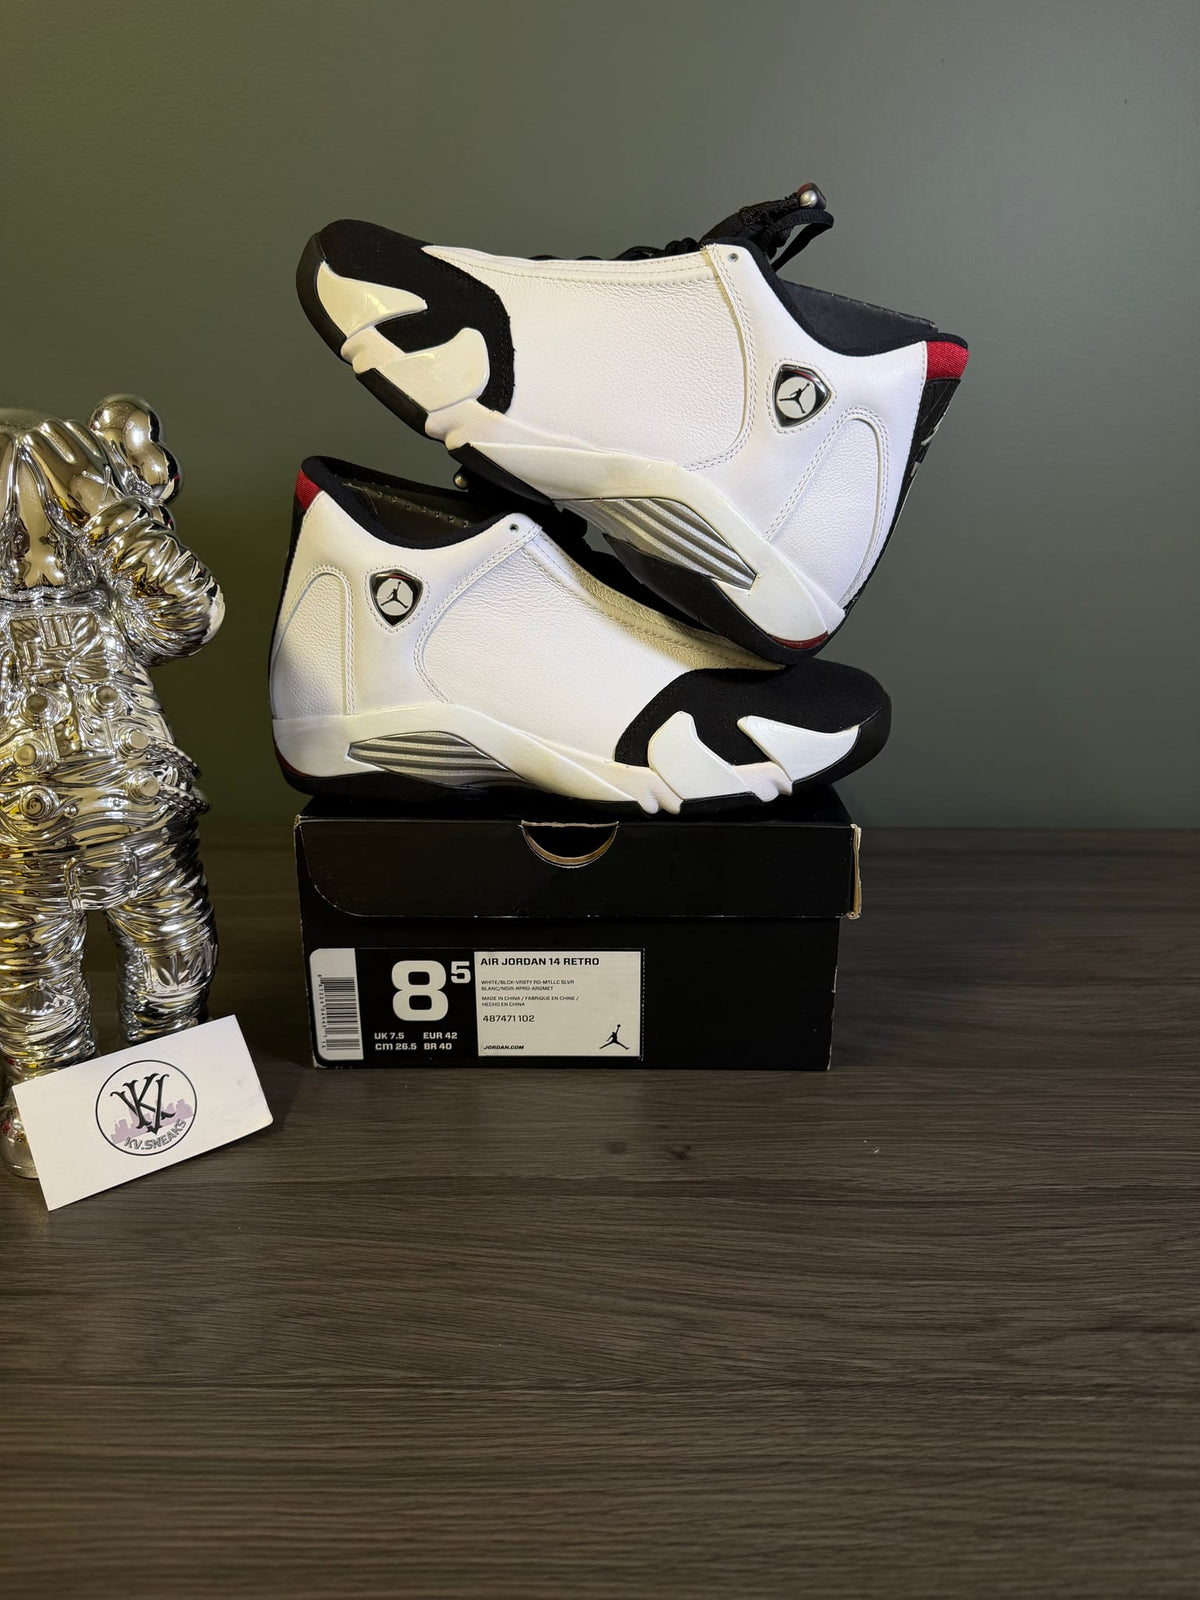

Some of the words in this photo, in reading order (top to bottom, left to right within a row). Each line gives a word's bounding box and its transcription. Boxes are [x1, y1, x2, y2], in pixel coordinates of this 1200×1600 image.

[480, 957, 499, 966] AIR
[501, 957, 546, 966] JORDAN
[548, 957, 561, 966] 14
[563, 957, 600, 966] RETRO
[374, 1032, 388, 1040] UK
[389, 1032, 405, 1040] 7.5
[423, 1032, 443, 1040] EUR
[444, 1032, 458, 1040] 42
[395, 1042, 417, 1050] 26.5
[423, 1042, 437, 1050] BR
[439, 1042, 452, 1050] 40
[123, 1118, 187, 1151] KV.SNEAKS
